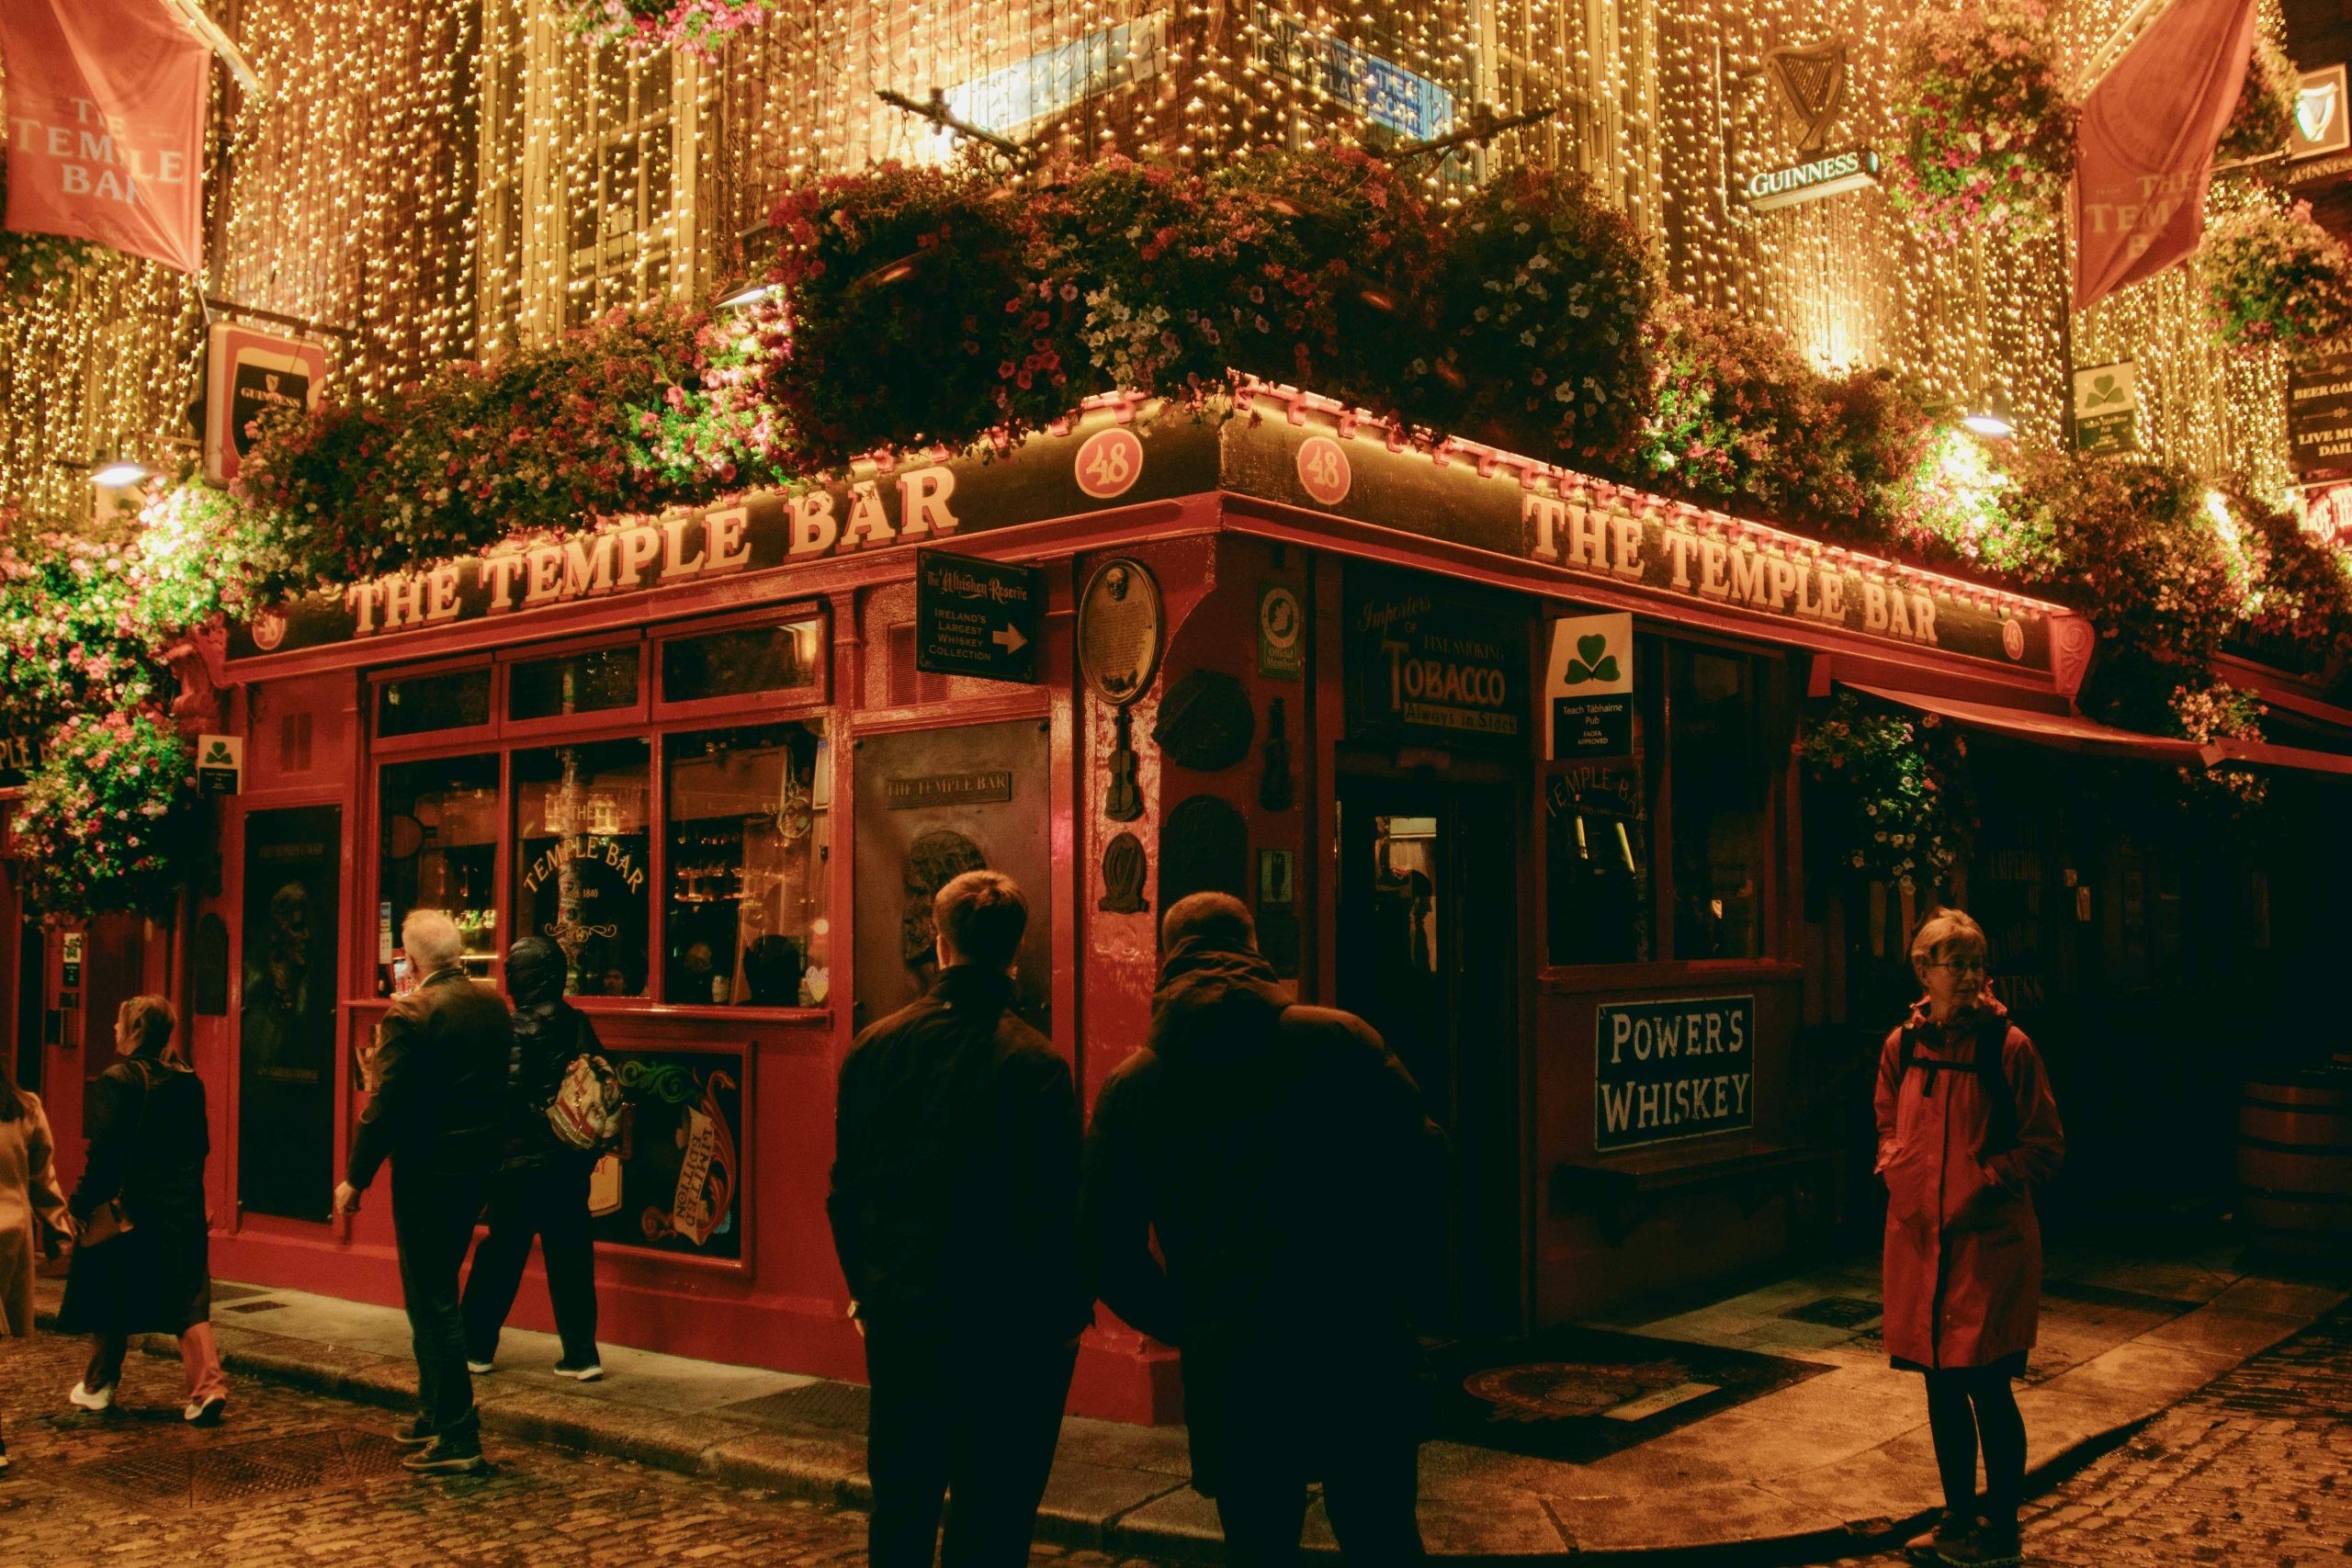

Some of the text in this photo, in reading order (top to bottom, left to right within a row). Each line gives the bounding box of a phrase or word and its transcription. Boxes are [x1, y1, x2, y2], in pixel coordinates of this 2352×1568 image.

[10, 116, 184, 184] TEMLE
[1749, 152, 1860, 197] GUINNESS
[241, 387, 301, 409] GUINESS
[2294, 381, 2352, 400] BEER GA
[2298, 430, 2334, 446] LIVE
[1086, 443, 1129, 486] 48
[1306, 446, 1340, 488] 48
[345, 467, 958, 637] THE TEMPLE BAR
[1522, 493, 1939, 643] THE TEMPLE BAR
[989, 577, 1028, 605] Reserve
[934, 607, 987, 625] IRELAND'S
[938, 620, 984, 636] LARGEST
[928, 644, 991, 661] COLLECTION
[938, 633, 984, 648] WHISKEY
[1382, 638, 1506, 713] TOBACCO
[1406, 704, 1516, 731] Always in Stock
[1563, 705, 1585, 716] Teach
[1585, 716, 1600, 725] Pub
[1577, 738, 1609, 746] APPROVED
[919, 778, 973, 795] TEMPLE
[977, 774, 1007, 791] BAR
[570, 805, 595, 820] THE
[524, 836, 644, 895] TEMPLE BAR
[582, 888, 598, 898] 1840
[1611, 1010, 1745, 1065] POWER'S
[1600, 1073, 1750, 1133] WHISKEY
[676, 1134, 702, 1219] EDITION
[684, 1127, 713, 1228] LIMITED
